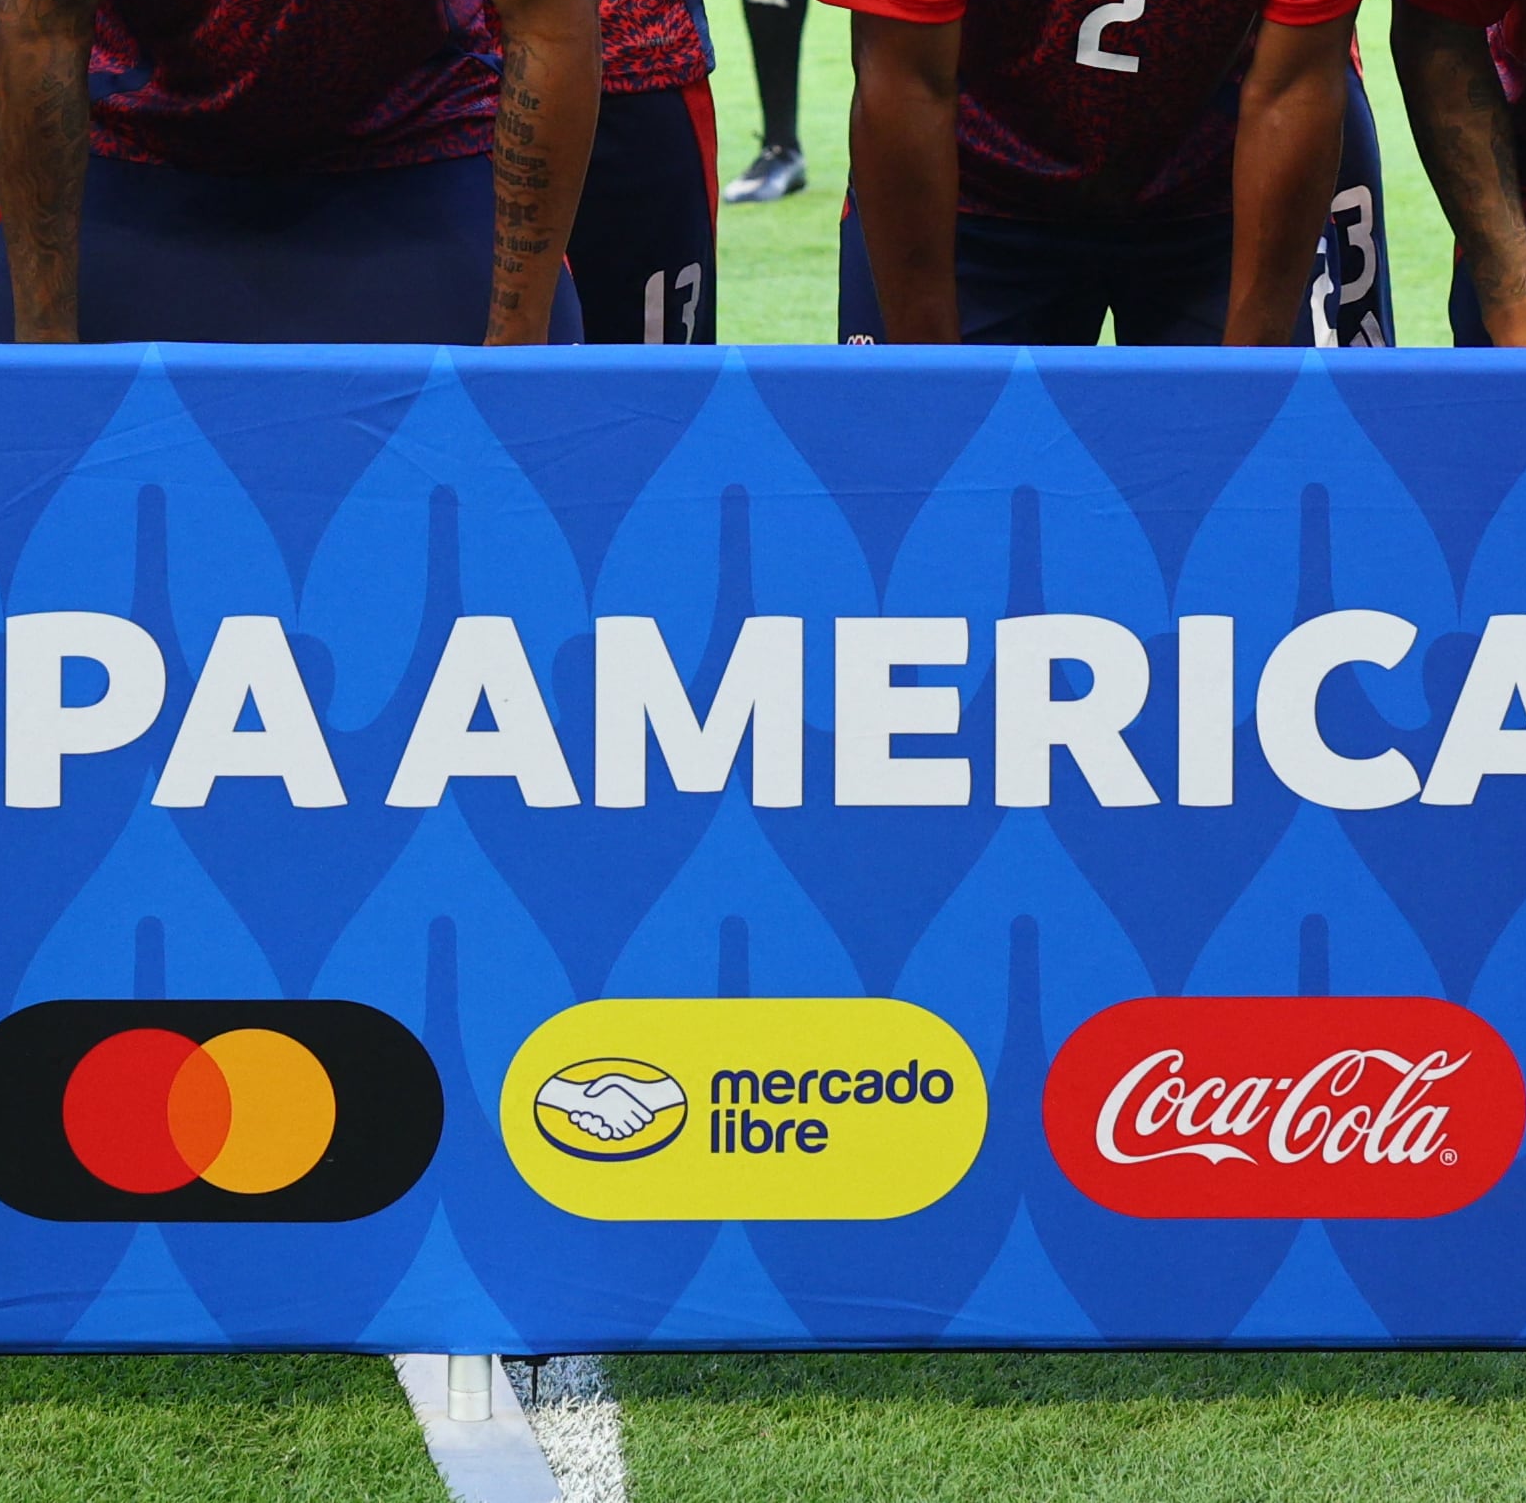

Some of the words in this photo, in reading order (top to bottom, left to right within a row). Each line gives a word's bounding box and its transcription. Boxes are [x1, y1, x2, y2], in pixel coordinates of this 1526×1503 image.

[1328, 185, 1374, 306] 3
[644, 262, 702, 344] 13
[710, 1059, 954, 1104] mercado
[1095, 1048, 1473, 1165] Coca-Cola
[710, 1113, 829, 1155] libre
